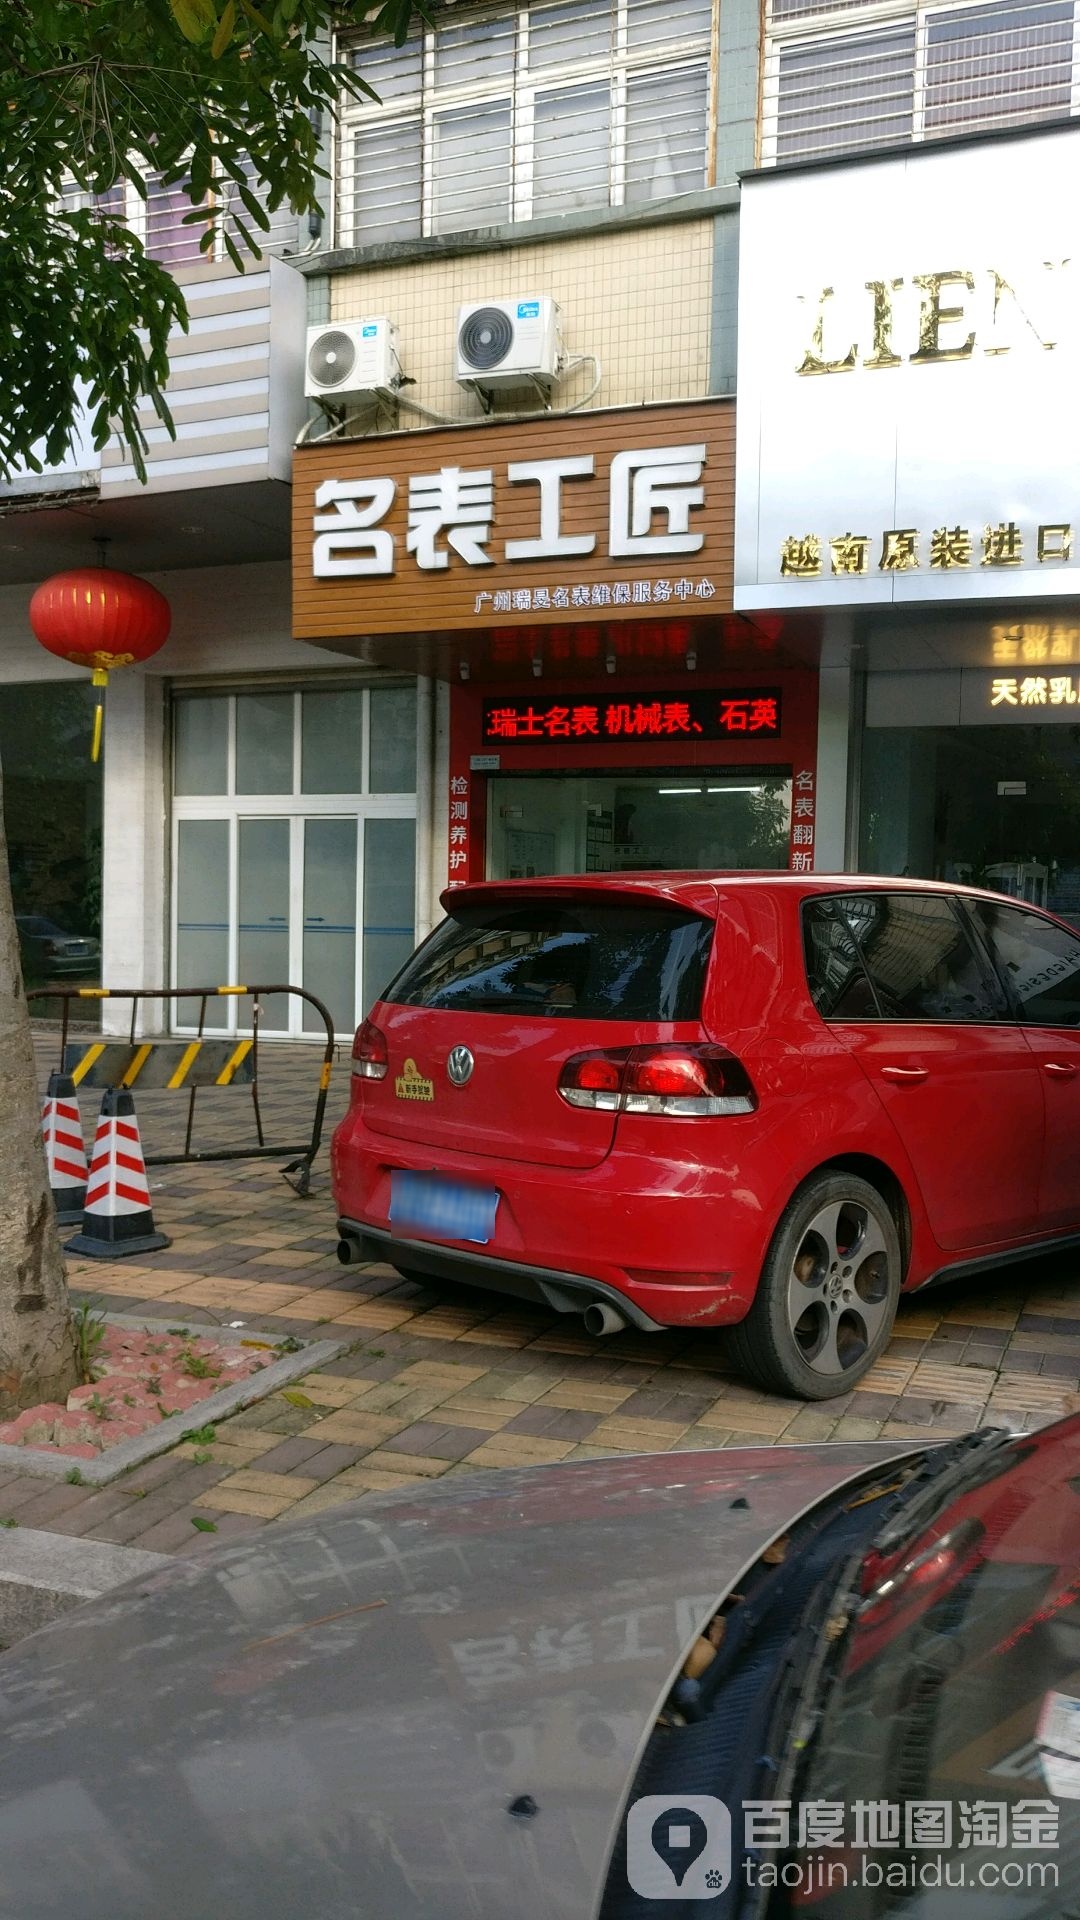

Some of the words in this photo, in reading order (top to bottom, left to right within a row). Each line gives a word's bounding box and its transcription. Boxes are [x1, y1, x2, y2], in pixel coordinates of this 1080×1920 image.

[312, 443, 707, 578] 名表工匠
[779, 521, 1075, 577] 越南原装进口
[474, 578, 716, 613] 广州瑞旻名表维保服务中心
[991, 676, 1080, 706] 天然乳
[449, 776, 468, 887] 检测养护
[792, 770, 813, 871] 名表翻新
